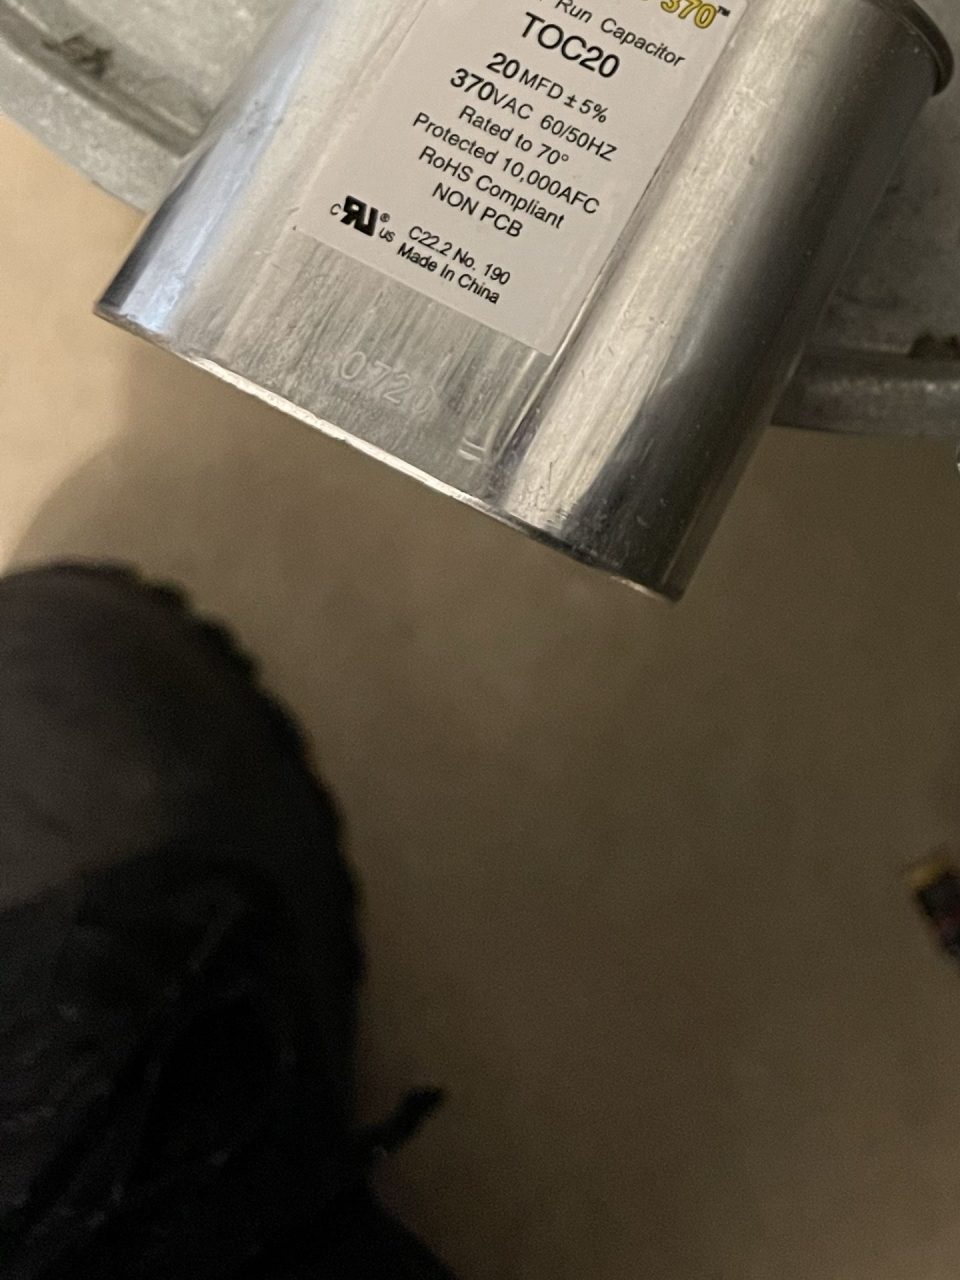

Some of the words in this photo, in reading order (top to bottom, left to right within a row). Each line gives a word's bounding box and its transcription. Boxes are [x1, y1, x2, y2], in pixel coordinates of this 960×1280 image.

[521, 11, 620, 78] TOC20
[600, 17, 686, 68] Capacitor
[450, 67, 534, 120] 370VAC
[540, 114, 618, 162] 60/50HZ
[458, 104, 515, 142] Rated
[515, 133, 533, 152] to
[412, 111, 500, 165] Protected
[502, 157, 601, 215] 10,000AFC
[418, 145, 474, 183] RoHS
[475, 174, 566, 230] Compliant
[432, 181, 480, 216] NON
[479, 205, 524, 238] PCB
[396, 241, 439, 272] Made
[439, 262, 456, 282] In
[457, 272, 501, 305] China
[408, 225, 453, 257] C22.2
[451, 246, 476, 271] No.
[483, 262, 511, 286] 190
